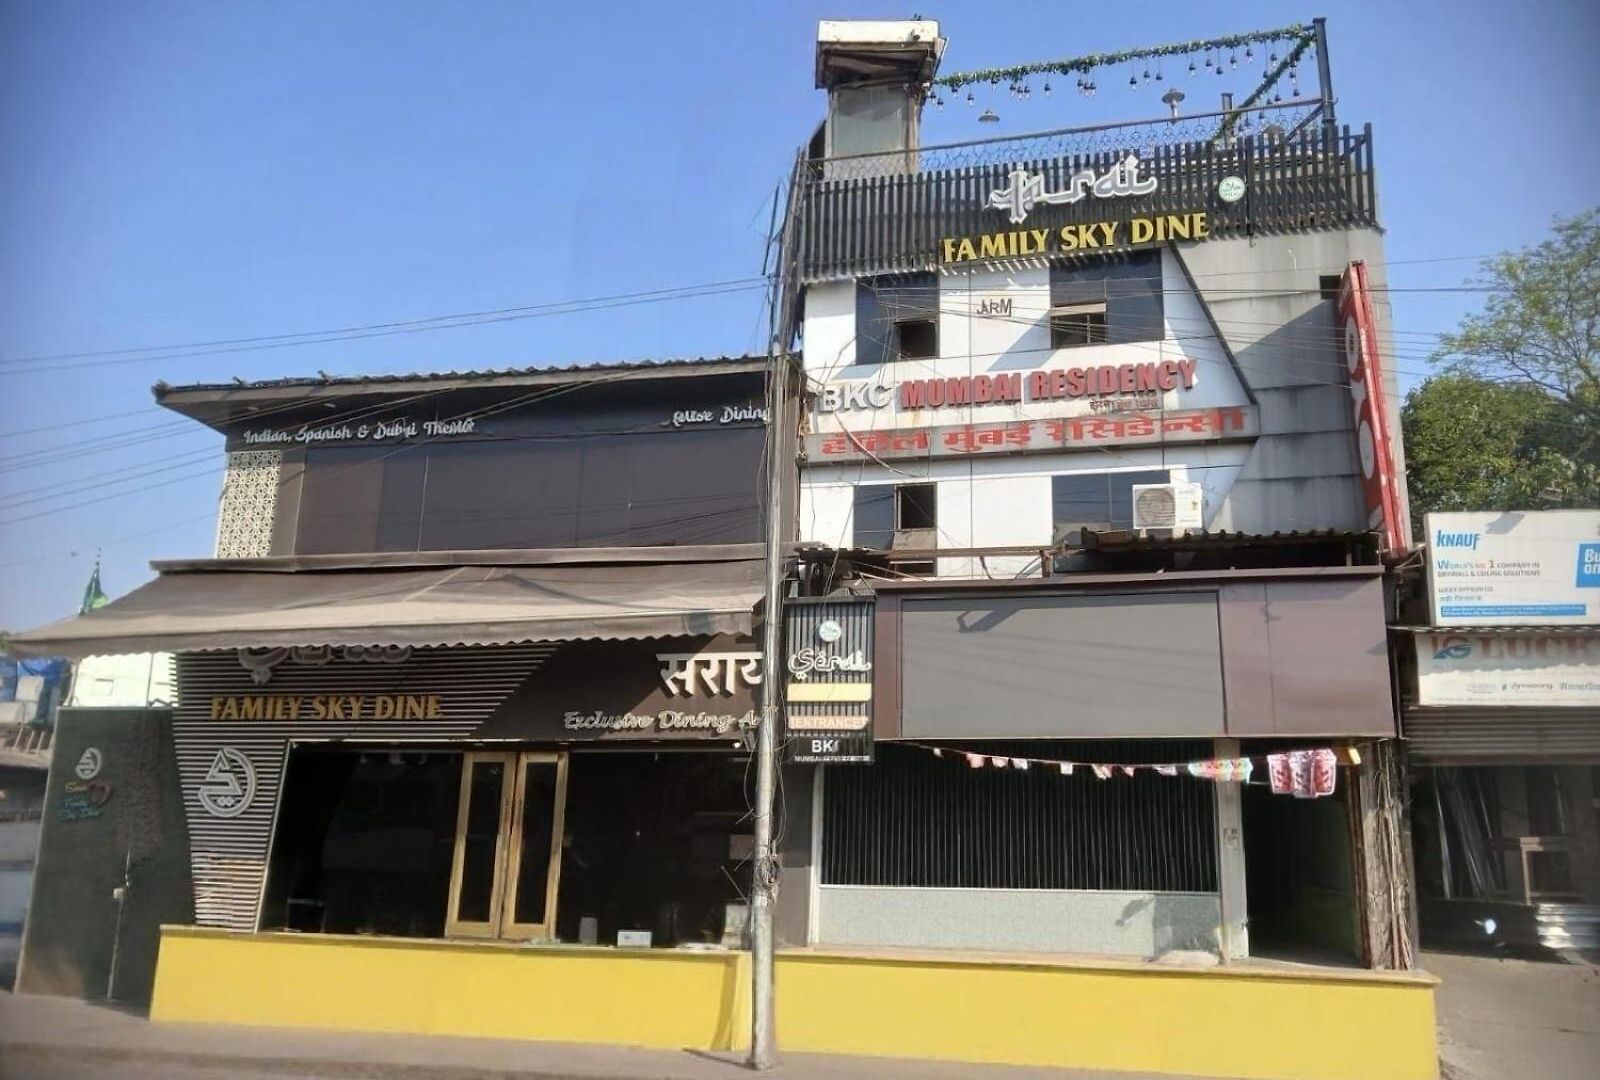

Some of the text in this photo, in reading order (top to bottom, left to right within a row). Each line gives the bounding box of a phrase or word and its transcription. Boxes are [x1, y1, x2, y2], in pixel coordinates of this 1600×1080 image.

[942, 211, 1210, 264] FAMILY SKY DINE
[820, 359, 1198, 412] BKC MUMBAI RESIDENCY
[243, 429, 292, 444] Indian,
[295, 426, 351, 443] Spanish
[357, 425, 370, 438] &
[373, 421, 417, 439] Dubai
[208, 694, 443, 721] FAMILY SKY DINE
[564, 711, 654, 729] Exclusive
[659, 710, 737, 734] Dining
